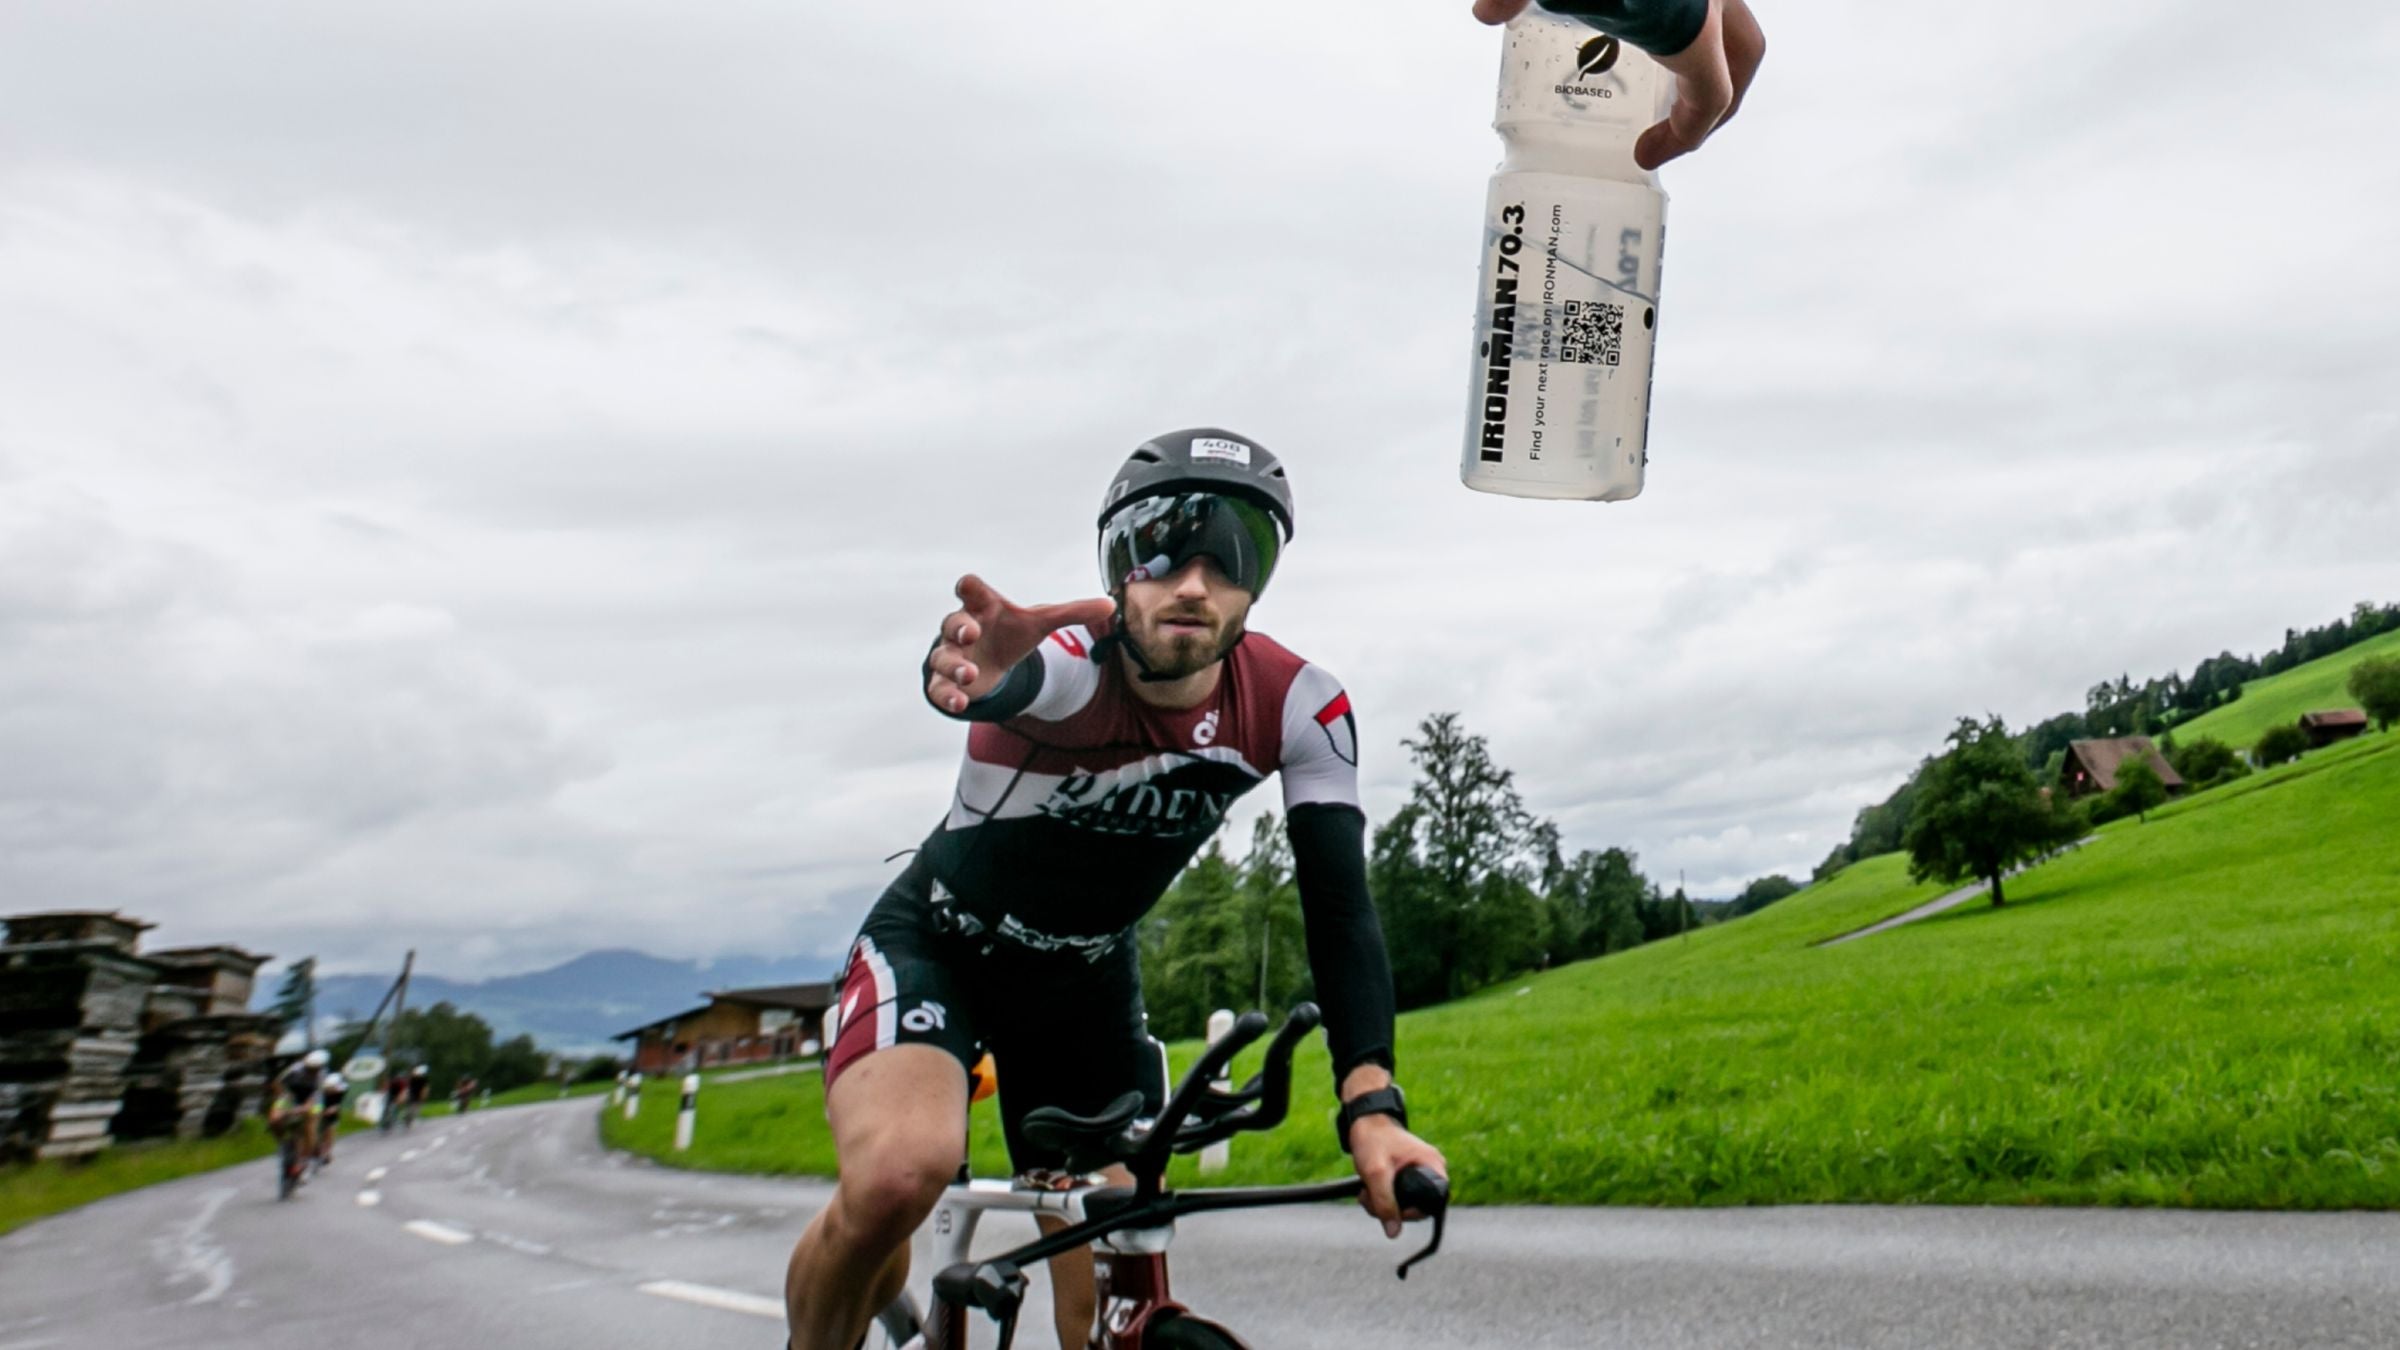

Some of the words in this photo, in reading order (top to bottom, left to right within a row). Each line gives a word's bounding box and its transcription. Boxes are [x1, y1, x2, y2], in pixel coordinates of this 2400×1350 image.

[1554, 84, 1613, 99] BIOBASED
[1543, 204, 1562, 305] IRONMAN.com
[1543, 309, 1554, 326] on
[1541, 328, 1551, 359] race
[1537, 363, 1549, 392] next
[1534, 396, 1546, 427] your
[1529, 430, 1543, 461] Find
